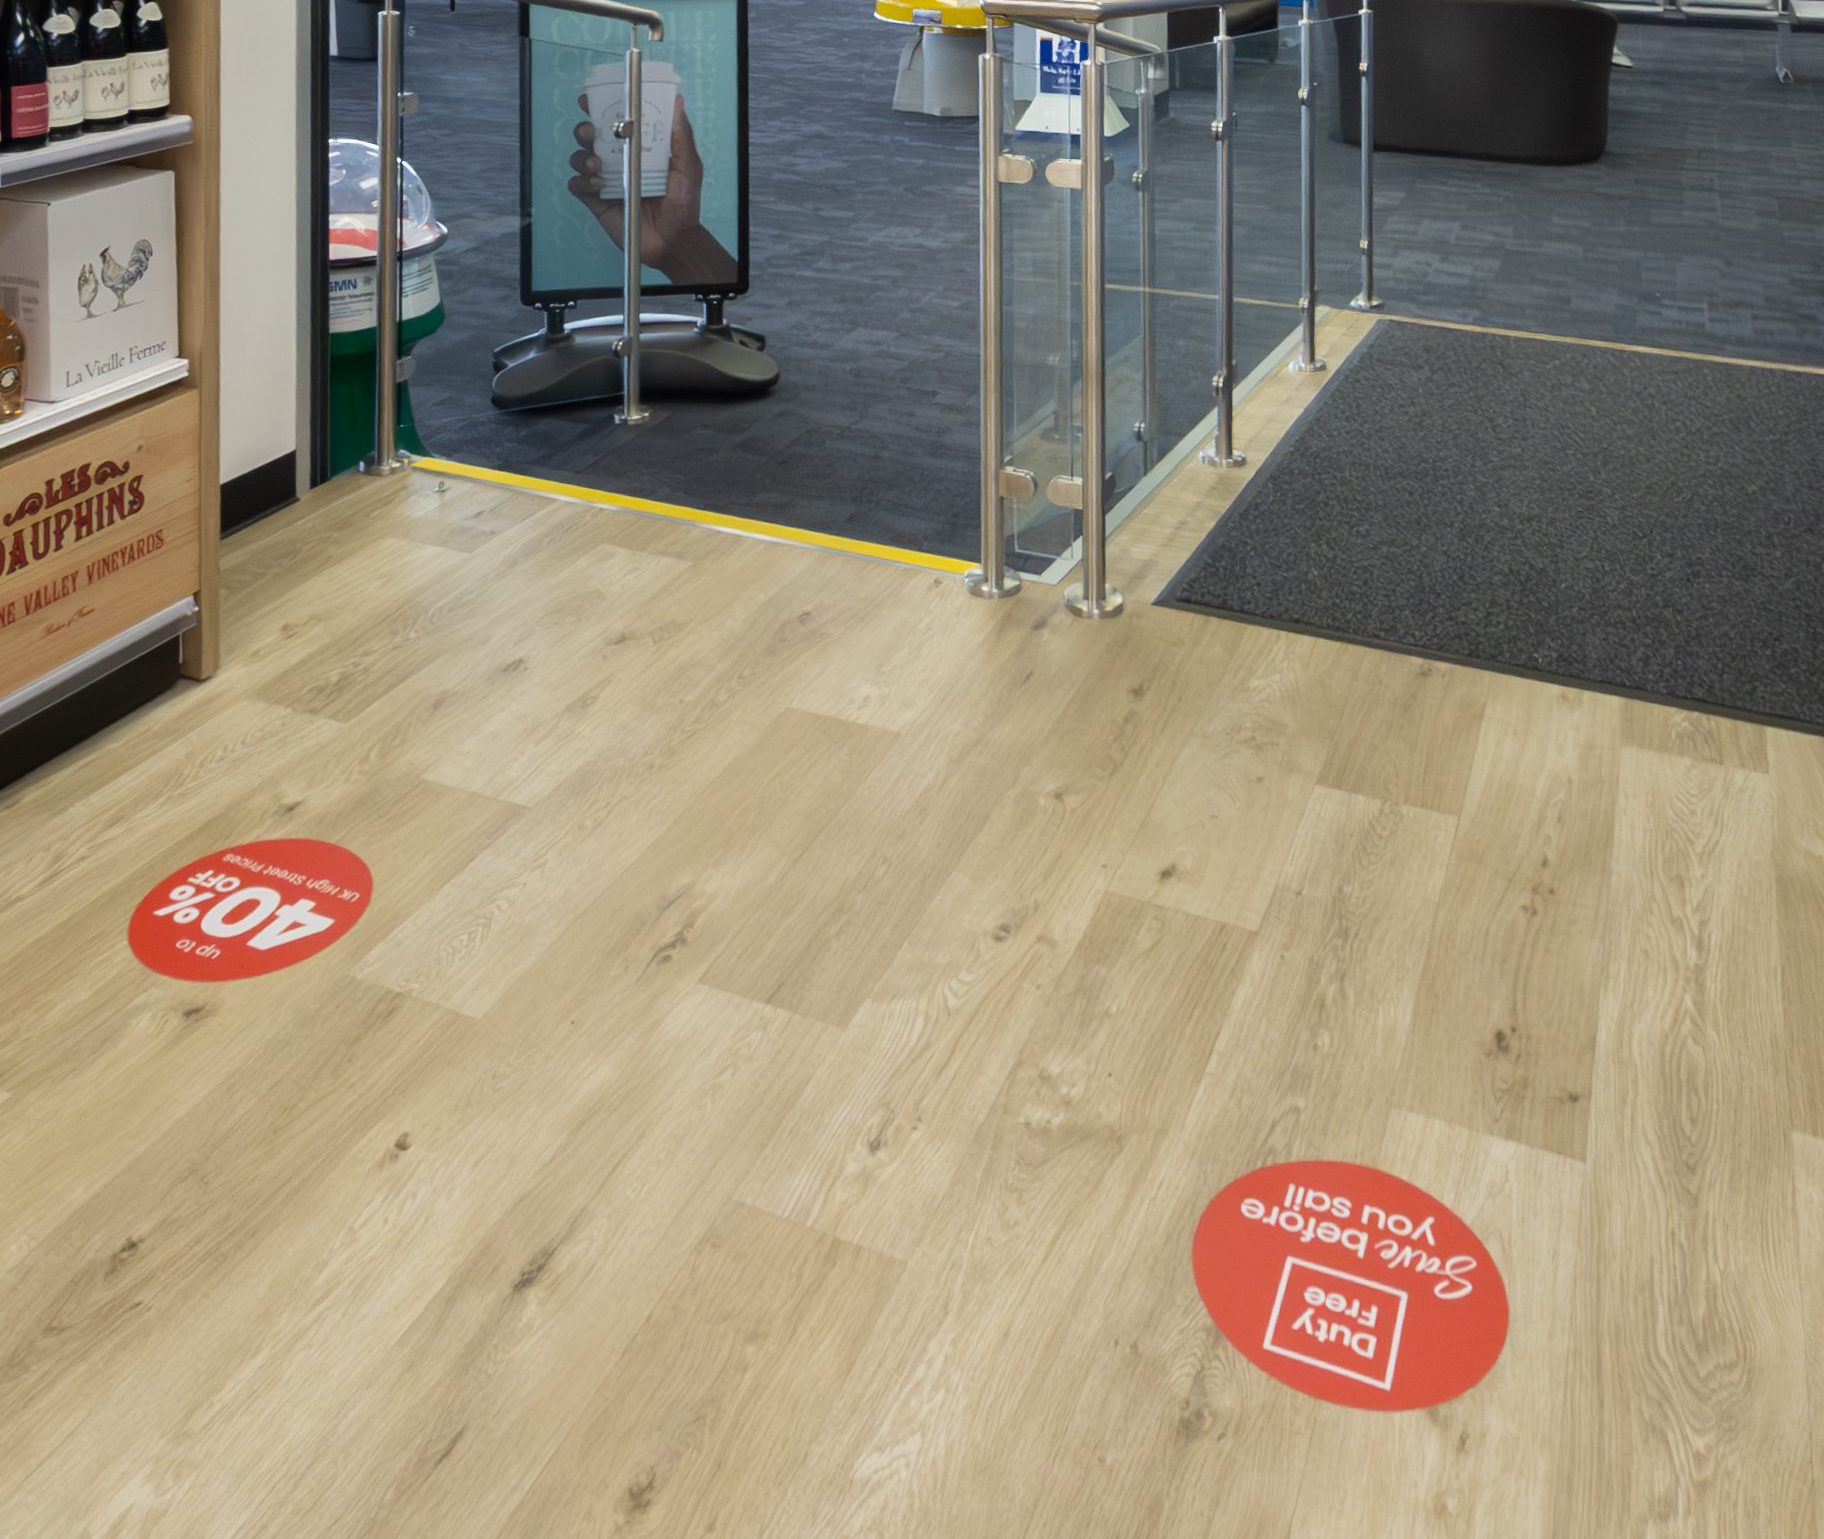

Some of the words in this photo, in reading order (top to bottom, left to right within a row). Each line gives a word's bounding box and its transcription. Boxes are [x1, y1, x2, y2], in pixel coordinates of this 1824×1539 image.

[64, 371, 83, 389] La
[86, 353, 124, 378] Vieille
[127, 337, 168, 362] Ferme
[44, 464, 93, 511] LES
[24, 570, 78, 622] VALLEY
[86, 528, 166, 586] VINEYARDS
[188, 869, 240, 894] OFF
[222, 853, 265, 872] Prices
[263, 865, 306, 885] Street
[306, 878, 340, 896] High
[338, 889, 360, 903] UK
[153, 884, 335, 951] 40%
[176, 938, 191, 950] to
[196, 943, 221, 960] up
[1283, 1183, 1353, 1218] sail
[1240, 1197, 1369, 1259] before
[1362, 1204, 1436, 1246] you
[1374, 1239, 1478, 1300] Save
[1303, 1286, 1379, 1328] Free
[1291, 1307, 1378, 1359] Duty
